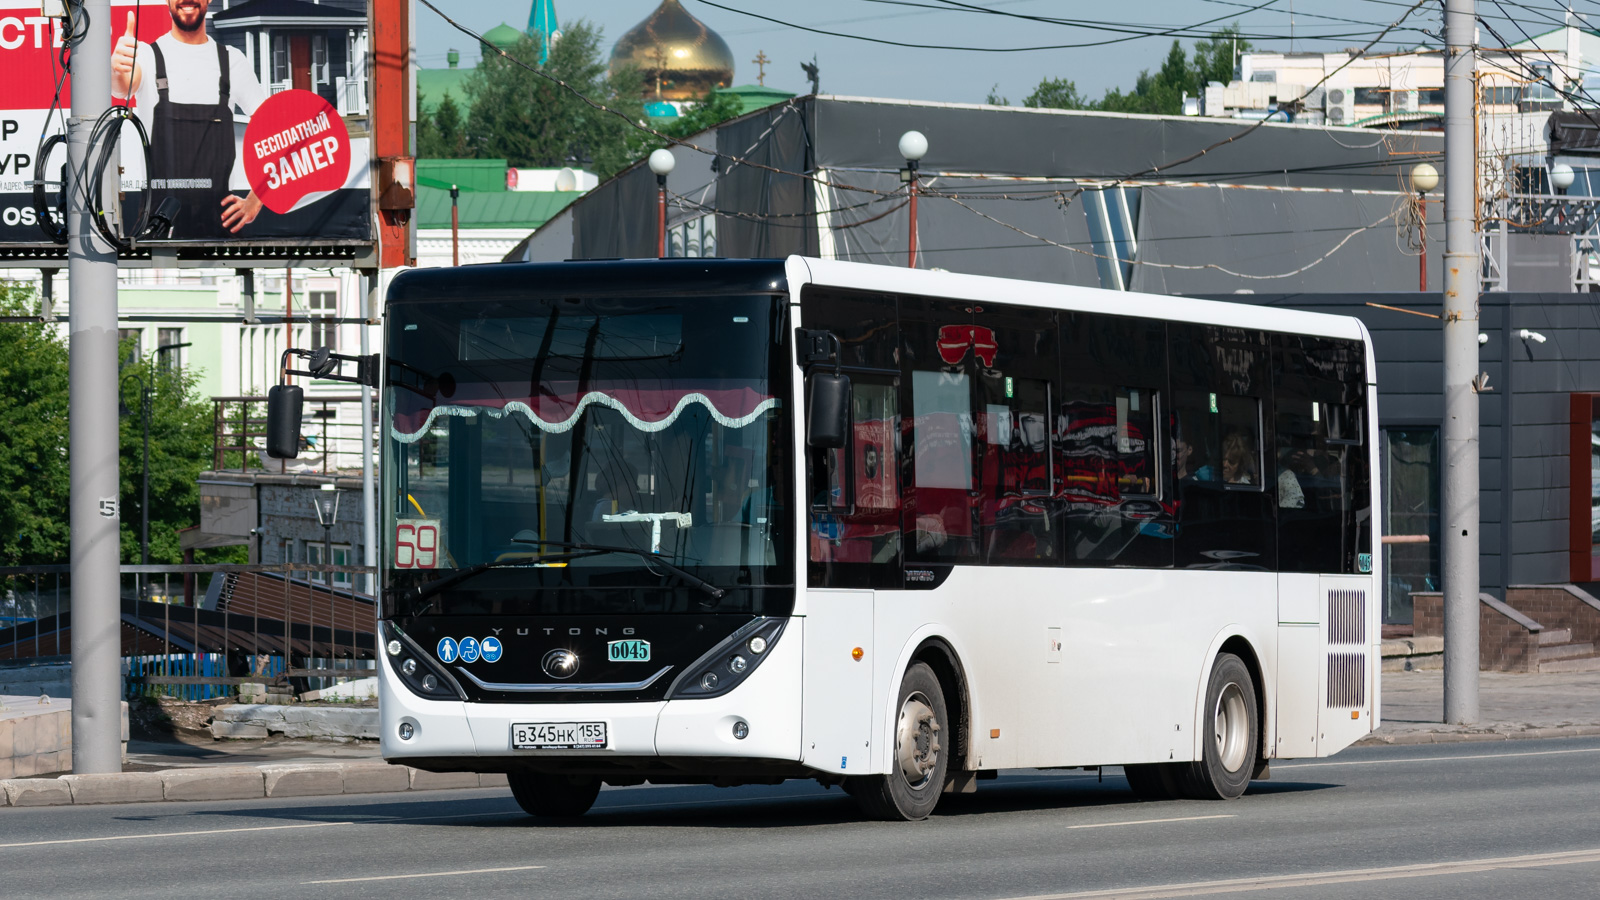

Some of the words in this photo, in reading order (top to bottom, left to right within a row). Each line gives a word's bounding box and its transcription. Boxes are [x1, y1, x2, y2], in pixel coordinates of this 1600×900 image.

[254, 111, 331, 159] БЕСПЛАТНЫЙ
[263, 136, 339, 190] ЗАМЕР
[395, 524, 437, 569] 69
[492, 627, 635, 636] YUTONG
[611, 641, 648, 659] 6045
[579, 724, 601, 738] 155
